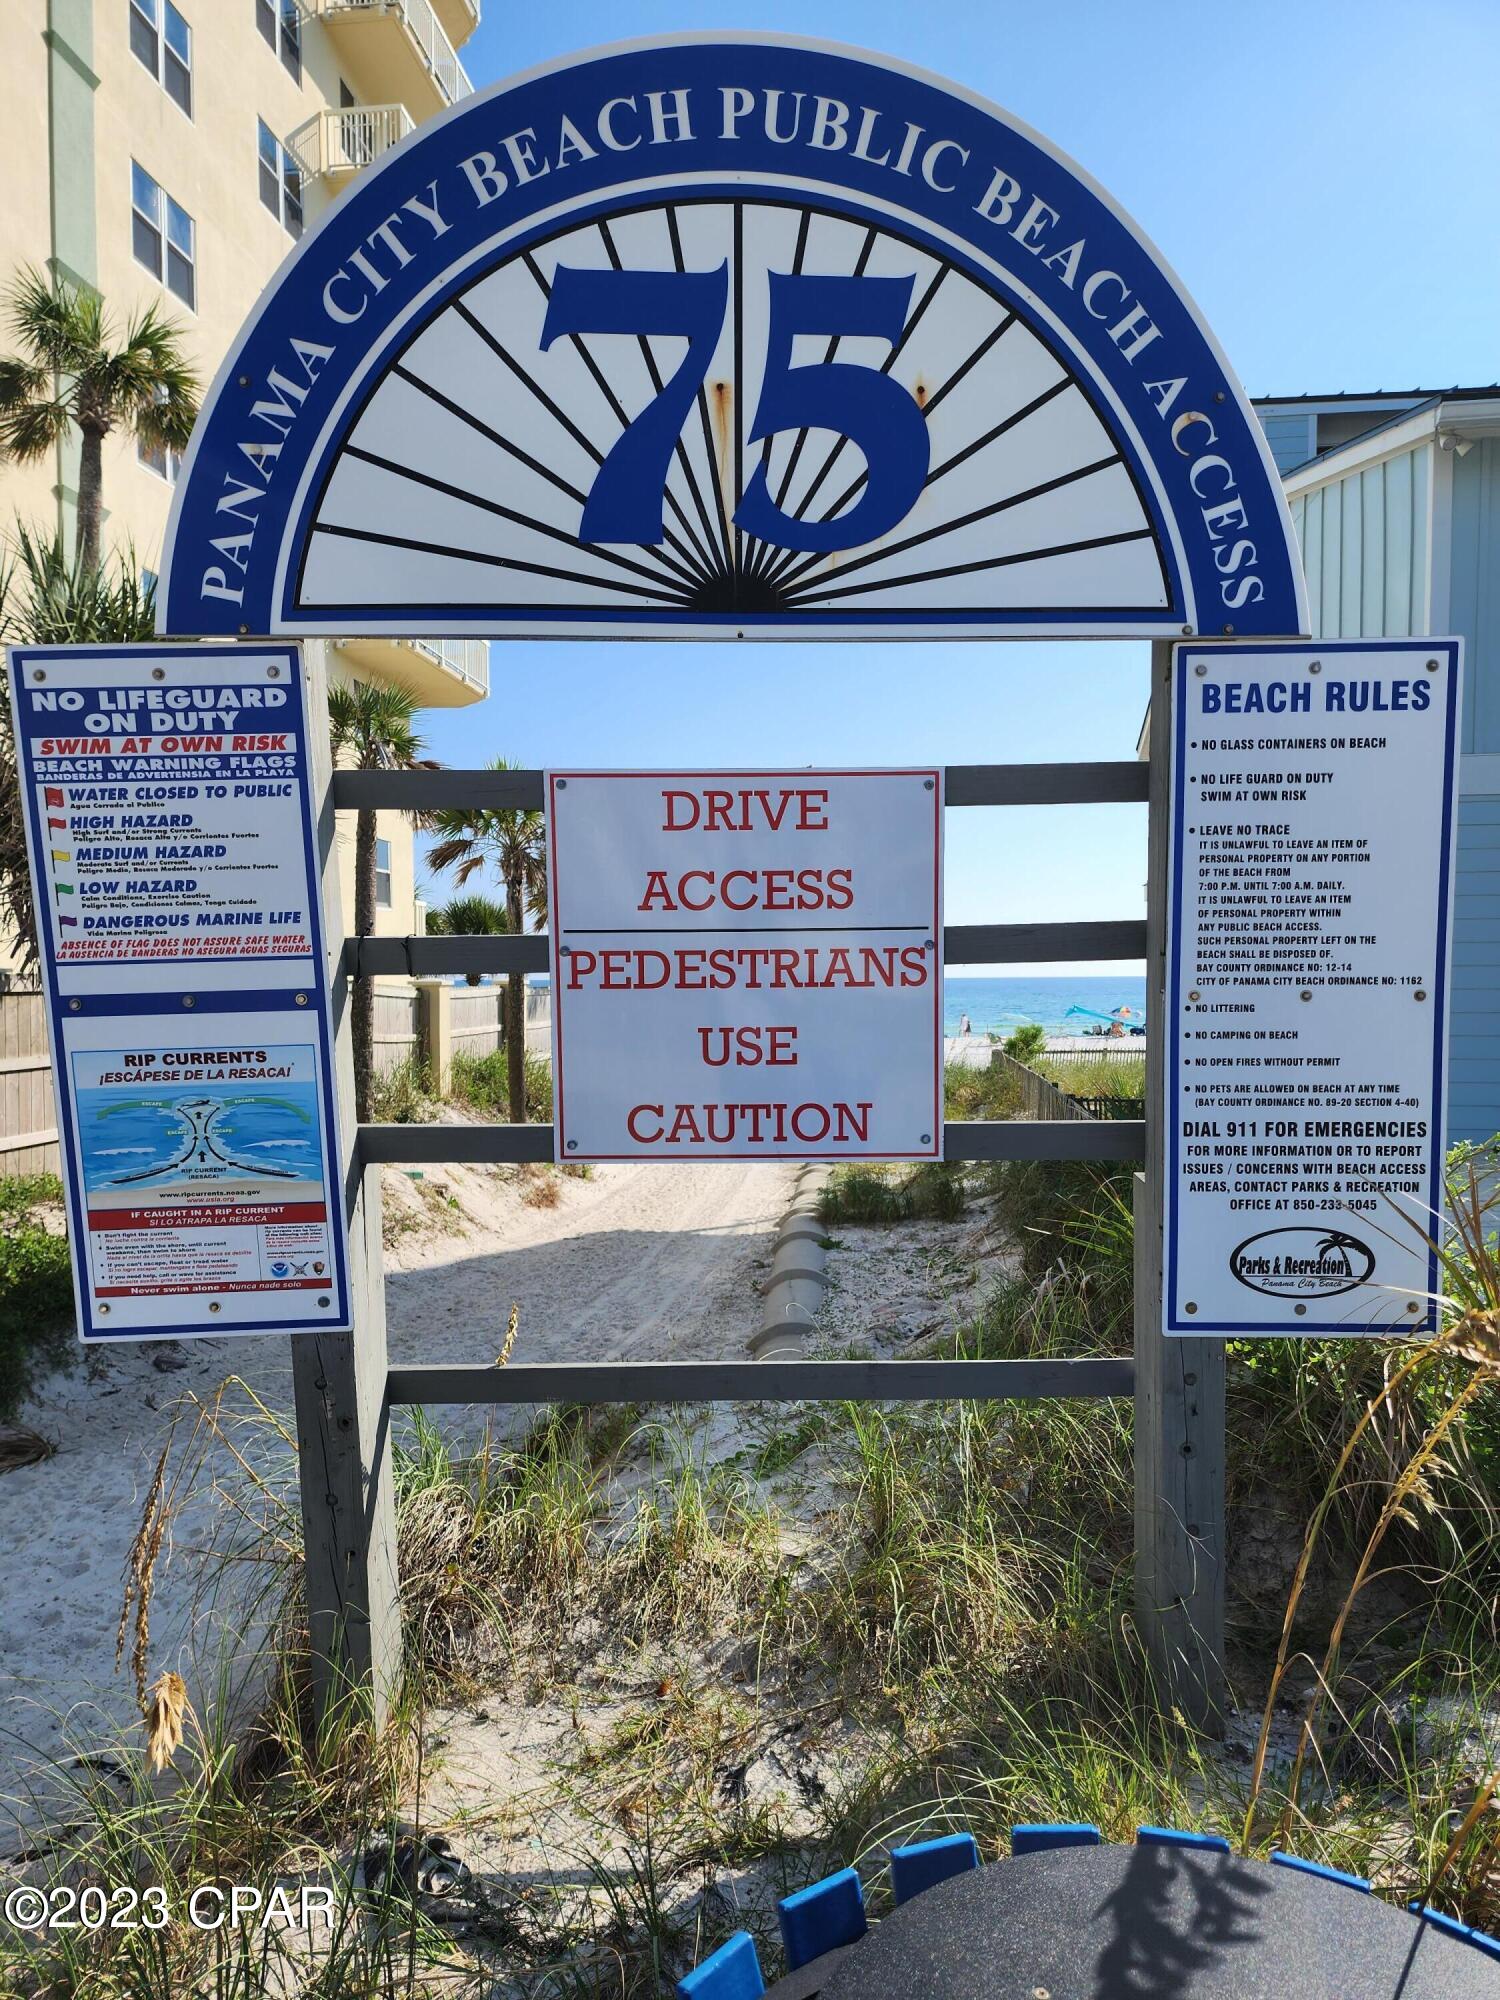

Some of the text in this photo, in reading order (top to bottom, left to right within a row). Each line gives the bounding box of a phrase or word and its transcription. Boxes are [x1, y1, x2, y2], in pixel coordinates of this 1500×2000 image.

[200, 87, 1265, 610] PANAMA CITY BEACH PUBLIC BEACH ACCESS
[538, 257, 931, 553] 75
[31, 687, 286, 711] NO LIFEGUARD
[1201, 679, 1430, 713] BEACH RULES
[84, 710, 238, 732] ON DUTY
[40, 734, 286, 755] SWIM AT OWN RISK
[1201, 737, 1386, 750] NO GLASS CONTAINERS ON BEACH
[32, 755, 296, 772] BEACH WARNING FLAGS
[36, 772, 102, 780] BANDERAS
[107, 771, 123, 779] DE
[127, 770, 210, 779] ADVERTENSIA
[215, 769, 231, 777] EN
[254, 768, 294, 776] PLAYA
[1200, 772, 1333, 784] NO LIFE GUARD ON DUTY
[68, 783, 291, 801] WATER CLOSED TO PUBLIC
[1200, 789, 1306, 801] SWIM AT OWN RISK
[661, 790, 829, 831] DRIVE
[70, 814, 192, 829] HIGH HAZARD
[1199, 824, 1290, 835] LEAVE NO TRACE
[75, 844, 226, 860] MEDIUM HAZARD
[1198, 867, 1290, 876] OF THE BEACH FROM
[79, 879, 197, 894] LOW HAZARD
[637, 869, 854, 912] ACCESS
[83, 911, 301, 928] DANGEROUS MARINE LIFE
[60, 934, 305, 950] ABSENCE OF FLAG DOES NOT ASSURE SAFE WATER
[56, 944, 311, 959] LA AUSENCIA DE BANDERAS NO ASEGURA AGUAS SEGURAS
[566, 946, 928, 990] PEDESTRIANS
[1195, 1003, 1255, 1012] NO LITTERING
[1195, 1030, 1298, 1039] NO CAMPING ON BEACH
[697, 1026, 798, 1067] USE
[123, 1050, 266, 1066] RIP CURRENTS
[1194, 1057, 1340, 1066] NO OPEN FIRES WITHOUT PERMIT
[99, 1069, 180, 1085] ¡ESCÁPESE
[183, 1069, 203, 1080] DE
[206, 1068, 224, 1079] LA
[626, 1102, 873, 1144] CAUTION
[1182, 1121, 1426, 1137] DIAL 911 FOR EMERGENCIES
[1187, 1145, 1422, 1156] FOR MORE INFORMATION OR TO REPORT
[1182, 1162, 1223, 1174] ISSUES
[1236, 1162, 1298, 1174] CONCERNS
[1302, 1163, 1332, 1174] WITH
[1336, 1163, 1375, 1174] BEACH
[1379, 1163, 1426, 1174] ACCESS
[1189, 1180, 1419, 1193] AREAS, CONTACT PARKS & RECREATION
[143, 1209, 187, 1217] CAUGHT
[234, 1206, 284, 1214] CURRENT
[1229, 1198, 1376, 1210] OFFICE AT 850-233-5045
[149, 1218, 158, 1226] SI
[1239, 1256, 1344, 1276] Parks & Recreation
[1262, 1278, 1342, 1288] Panama City Beach
